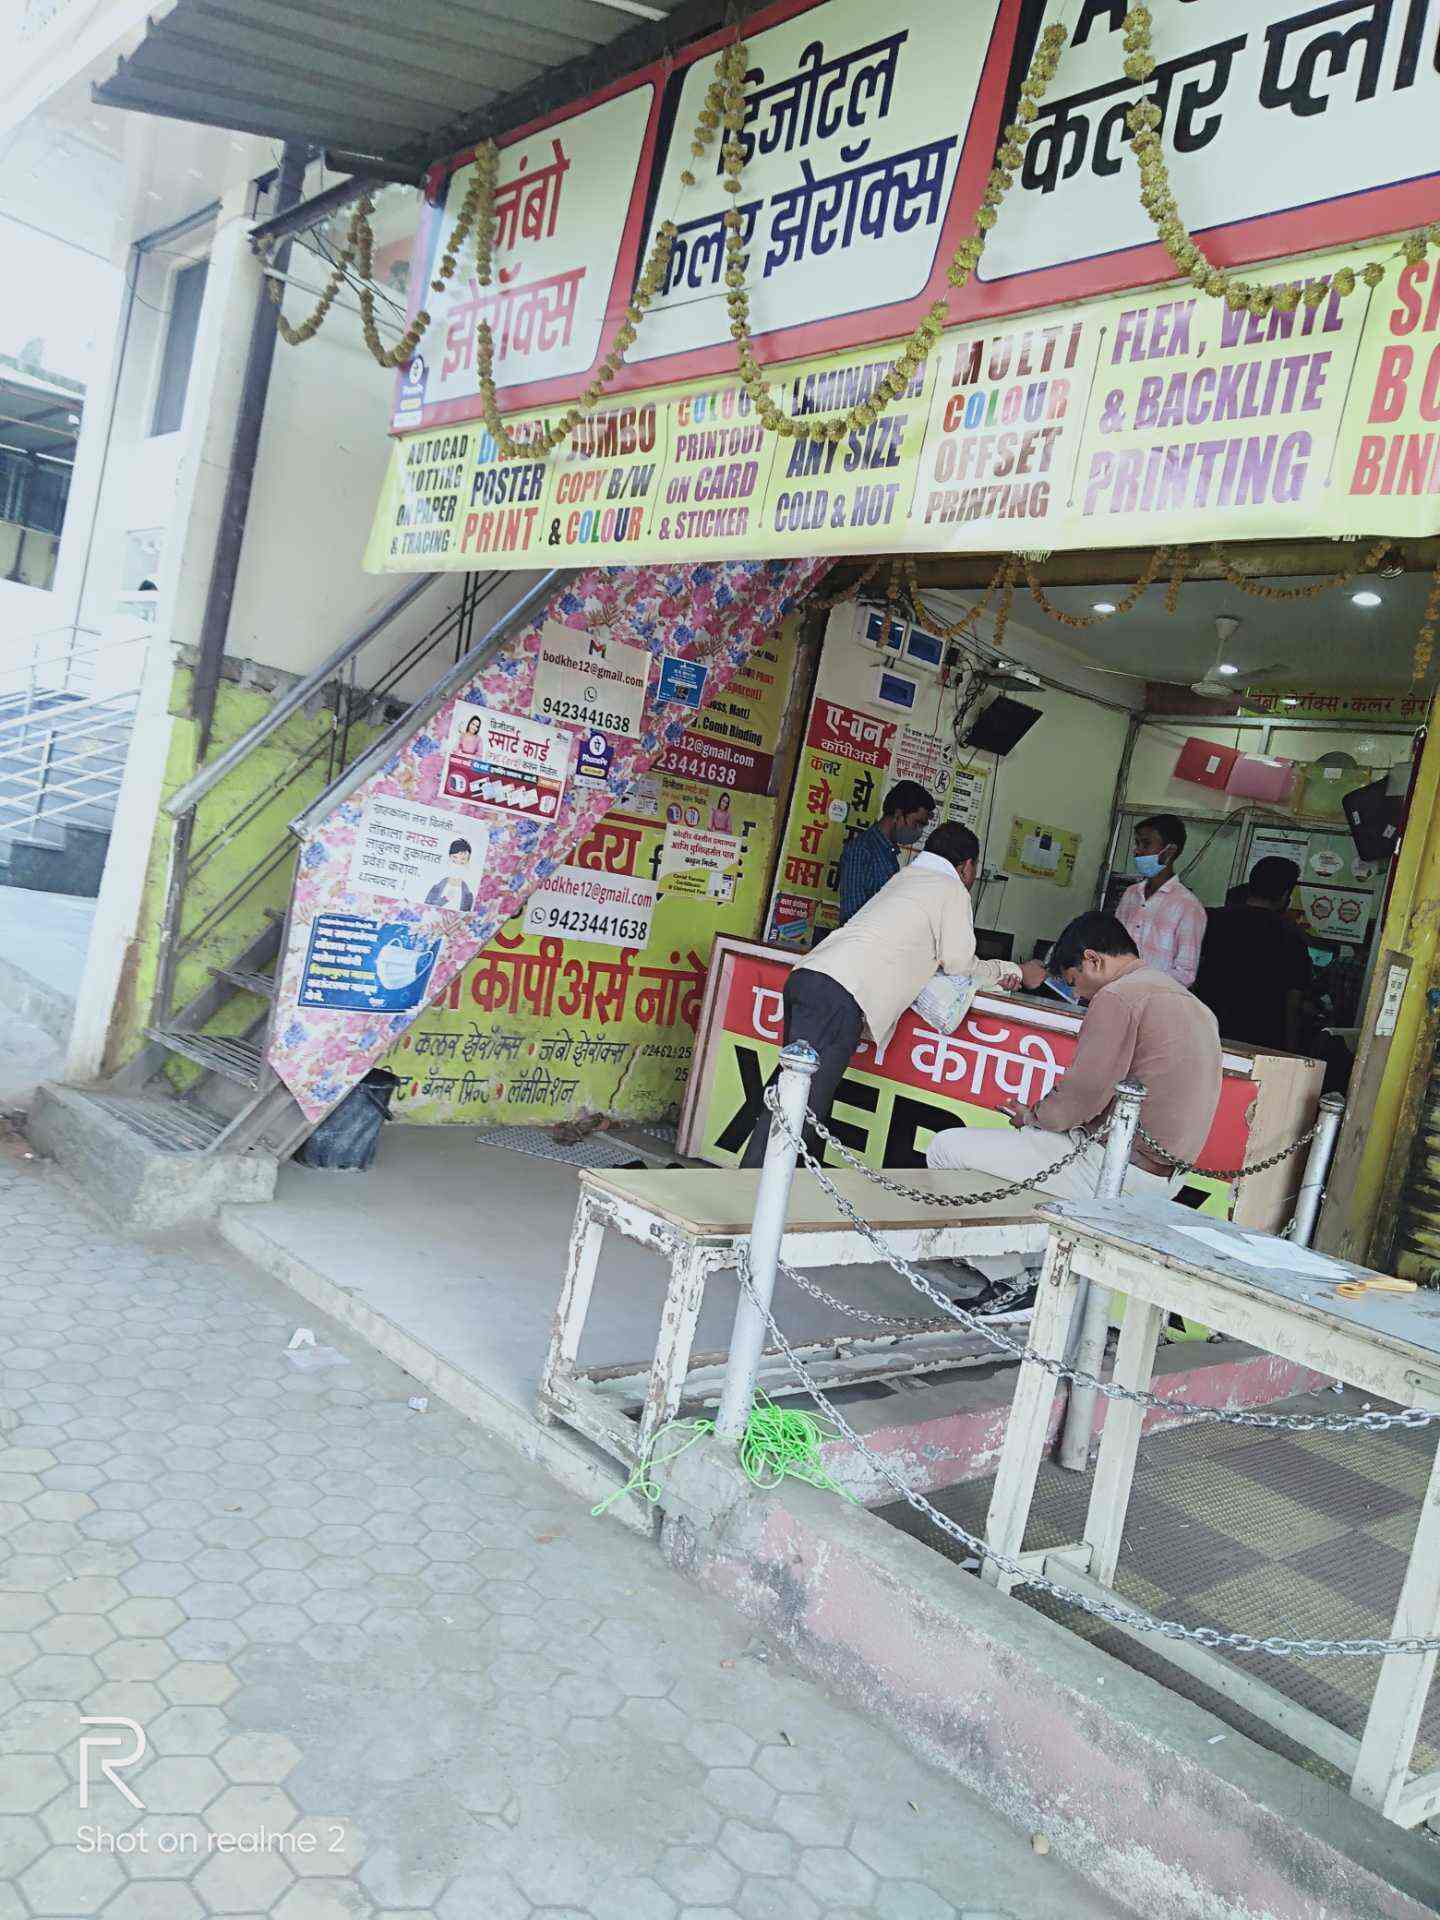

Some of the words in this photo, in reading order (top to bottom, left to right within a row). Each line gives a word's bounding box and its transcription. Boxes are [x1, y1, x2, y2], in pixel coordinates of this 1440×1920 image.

[1021, 33, 1248, 194] कलर
[763, 135, 959, 279] झेरॉक्स
[440, 262, 587, 383] झेरॉक्स
[951, 321, 1083, 388] MULTI
[942, 376, 1071, 433] COLOUR
[1099, 387, 1126, 434] &
[1133, 350, 1334, 431] BACKLITE
[406, 433, 469, 467] AUTOCAD
[566, 403, 657, 462] JUMBO
[674, 423, 764, 464] PRINTOUT
[785, 436, 841, 478] ANY
[843, 414, 908, 472] SIZE
[933, 426, 1063, 484] OFFSET
[470, 462, 547, 507] POSTER
[556, 468, 608, 505] COPY
[606, 463, 657, 500] B/W
[665, 475, 692, 505] ON
[693, 460, 759, 502] CARD
[1082, 430, 1312, 516] PRINTING
[658, 516, 671, 541] &
[674, 506, 750, 540] STICKER
[774, 490, 829, 533] COLD
[830, 493, 847, 528] &
[850, 482, 900, 527] HOT
[924, 478, 1051, 525] PRINTING
[400, 528, 450, 555] TRACING
[460, 506, 539, 553] PRINT
[548, 517, 562, 546] &
[565, 506, 644, 546] COLOUR
[541, 651, 644, 688] bodkhe12@gmail.com
[542, 697, 631, 734] 9423441638
[825, 705, 885, 748] ए-वन
[488, 729, 521, 754] स्मार्ट
[523, 738, 550, 761] कार्ड
[810, 755, 842, 777] कलर
[820, 739, 879, 767] कॉपीअर्स
[548, 908, 648, 941] 9423441638
